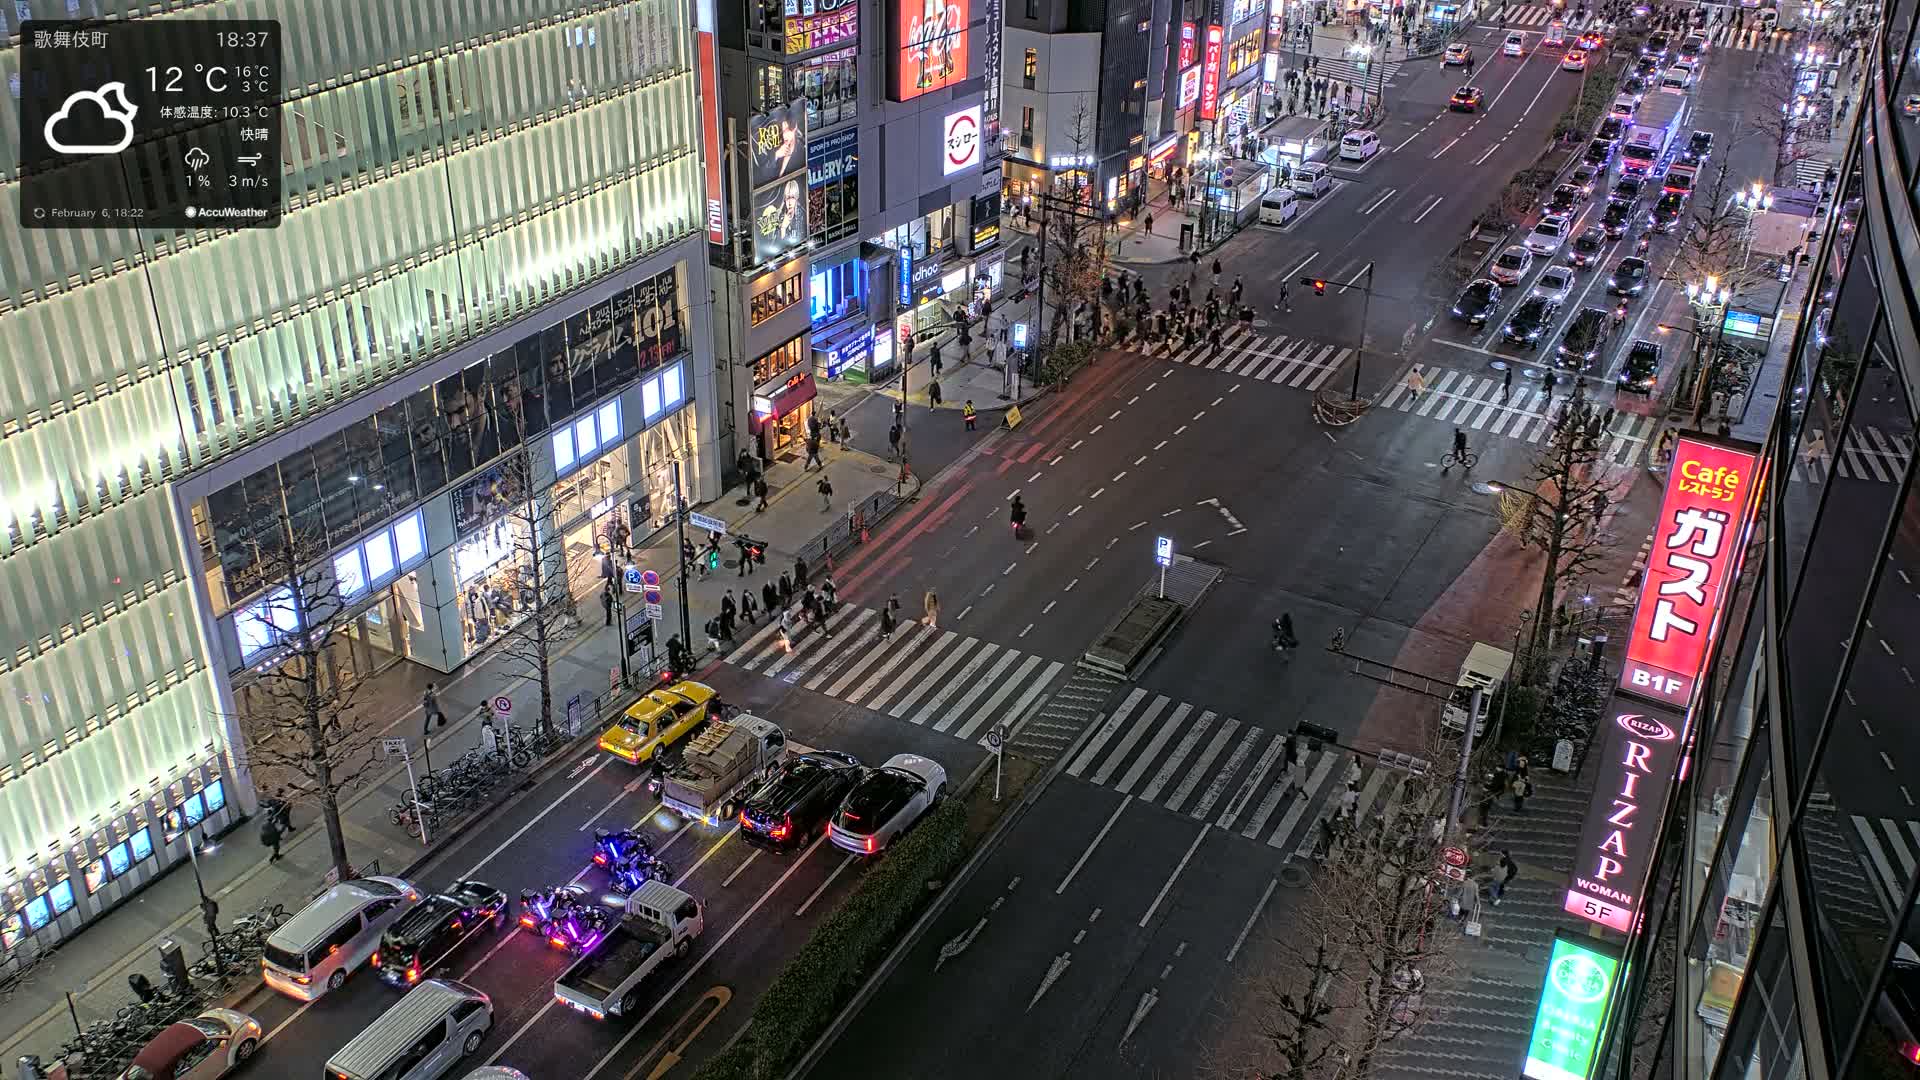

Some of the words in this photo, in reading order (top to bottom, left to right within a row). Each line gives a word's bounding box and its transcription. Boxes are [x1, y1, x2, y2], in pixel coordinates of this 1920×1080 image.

[1204, 45, 1221, 111] バーガーキング
[810, 141, 830, 154] SPORTS
[831, 136, 841, 147] PRO
[842, 132, 855, 143] SHOP
[947, 133, 978, 150] スシロー
[708, 198, 721, 232] MUJI
[595, 305, 610, 319] クリス
[617, 294, 633, 308] マーク
[631, 300, 676, 347] 101
[1681, 460, 1739, 488] Café
[1678, 480, 1736, 502] レストラン
[1159, 539, 1168, 548] P
[628, 572, 635, 581] P
[1651, 507, 1729, 642] ガスト
[1632, 669, 1682, 695] B1F
[1629, 719, 1662, 734] RIZAP
[1594, 740, 1652, 881] RIZAP
[1577, 877, 1632, 904] WOMAN
[1583, 902, 1614, 920] 5F
